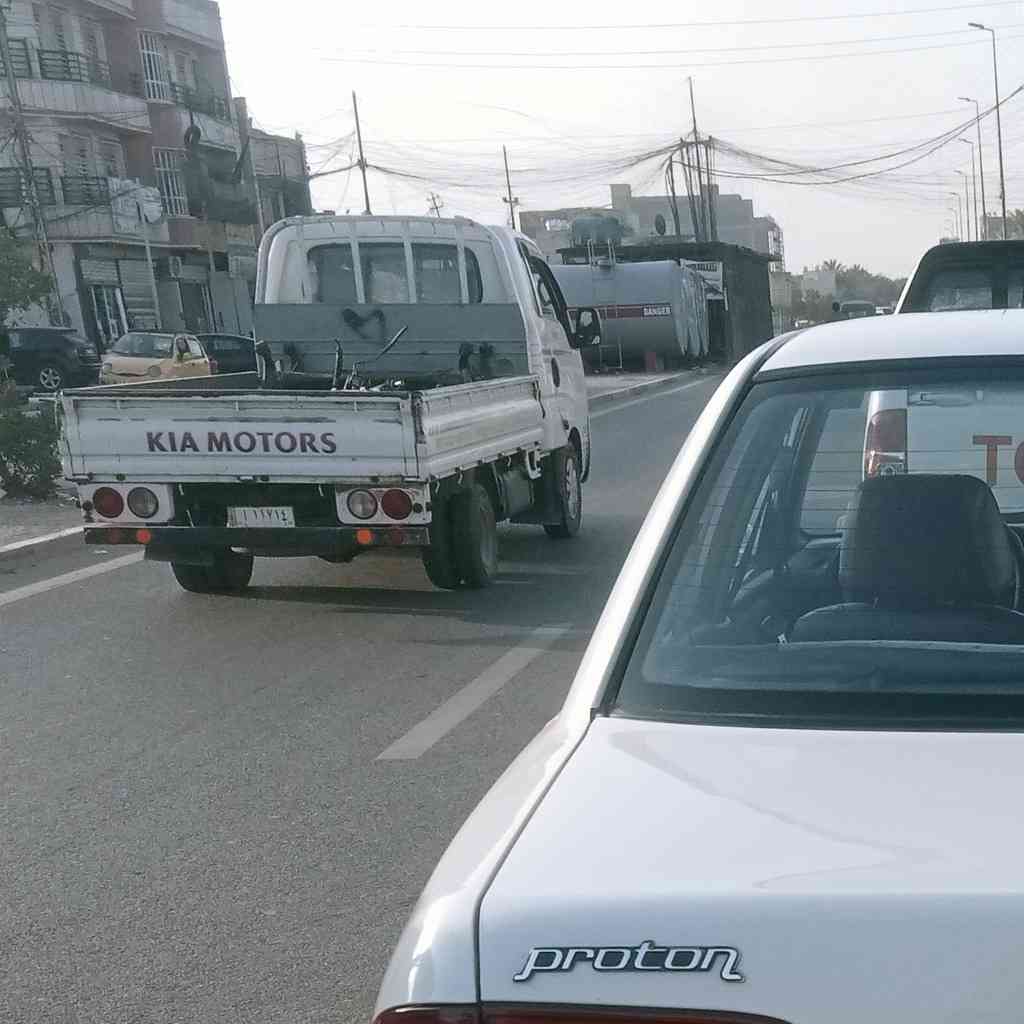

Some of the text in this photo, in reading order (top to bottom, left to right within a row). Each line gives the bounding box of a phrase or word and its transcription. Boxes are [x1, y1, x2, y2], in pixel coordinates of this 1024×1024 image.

[146, 431, 337, 454] KIA MOTORS
[512, 940, 746, 983] proton
